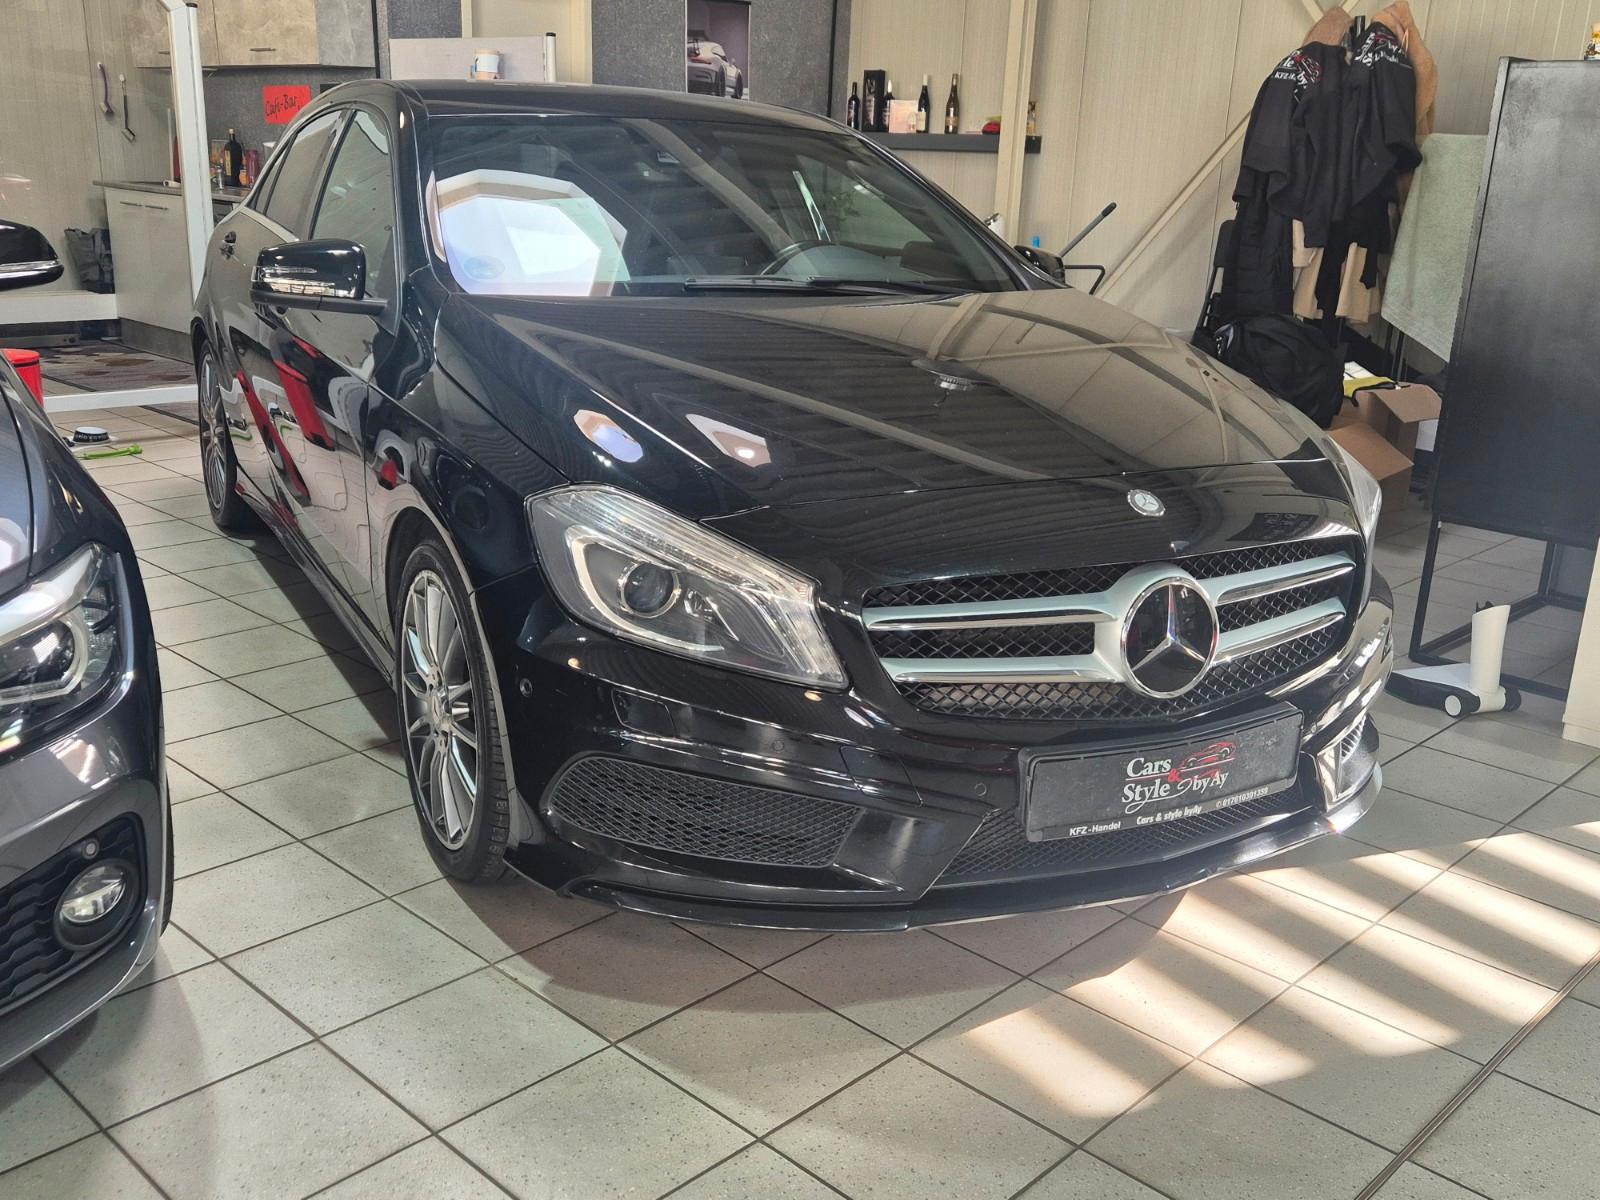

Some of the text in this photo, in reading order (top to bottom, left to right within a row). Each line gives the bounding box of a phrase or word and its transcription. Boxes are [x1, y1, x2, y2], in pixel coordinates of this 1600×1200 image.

[1126, 757, 1172, 778] Cars
[1167, 768, 1182, 782] &
[1121, 779, 1175, 814] Style
[1136, 815, 1154, 825] Cars
[1155, 812, 1163, 822] &
[1164, 808, 1183, 821] style
